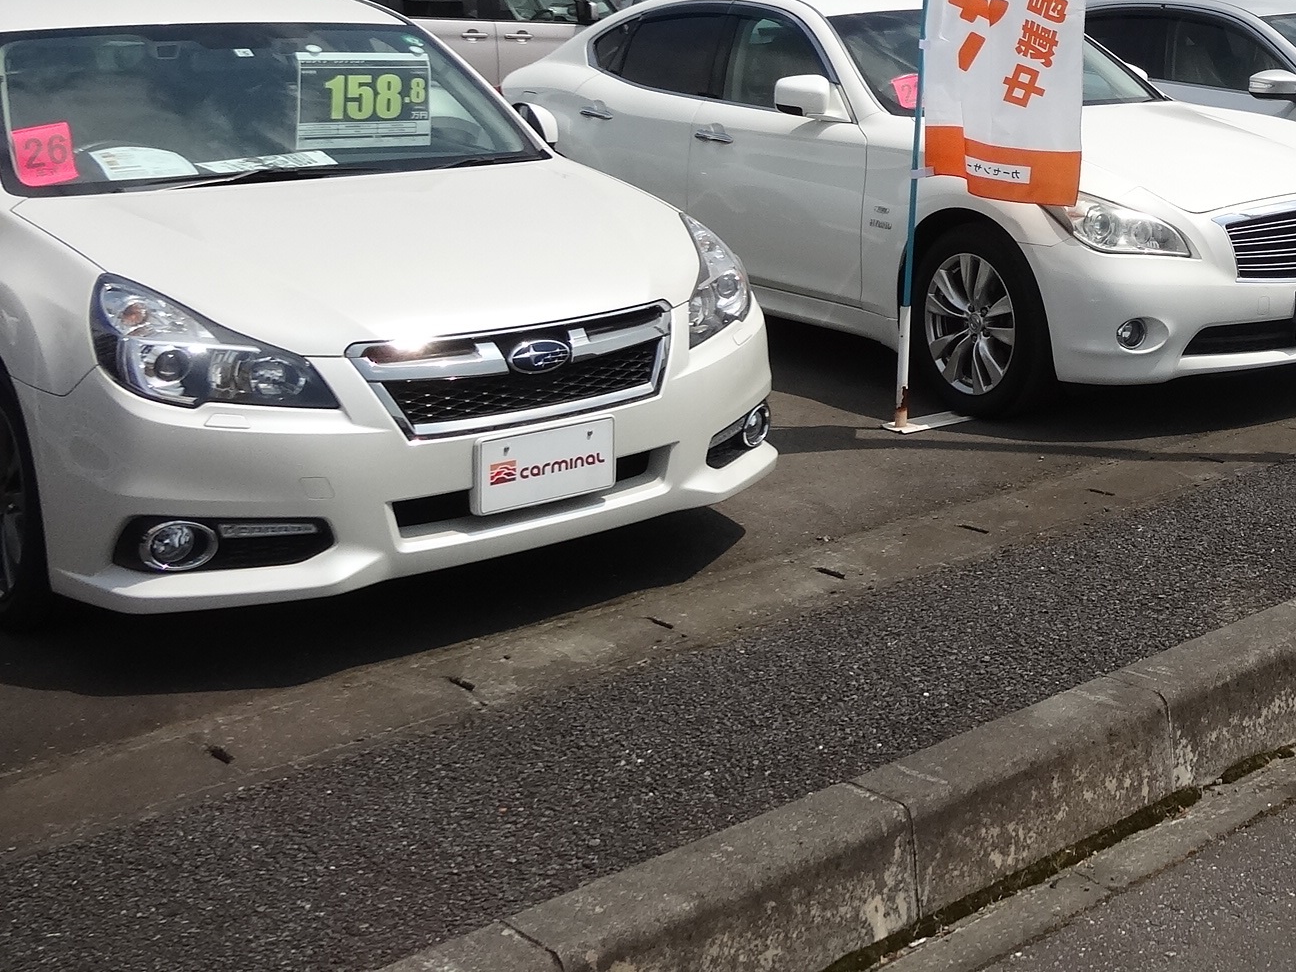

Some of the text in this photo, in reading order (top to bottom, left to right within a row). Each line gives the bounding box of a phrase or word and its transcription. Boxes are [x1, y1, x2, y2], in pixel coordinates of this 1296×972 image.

[325, 73, 426, 120] 158.8
[411, 110, 428, 120] 万円
[23, 133, 69, 169] 26
[520, 452, 606, 479] carminal
